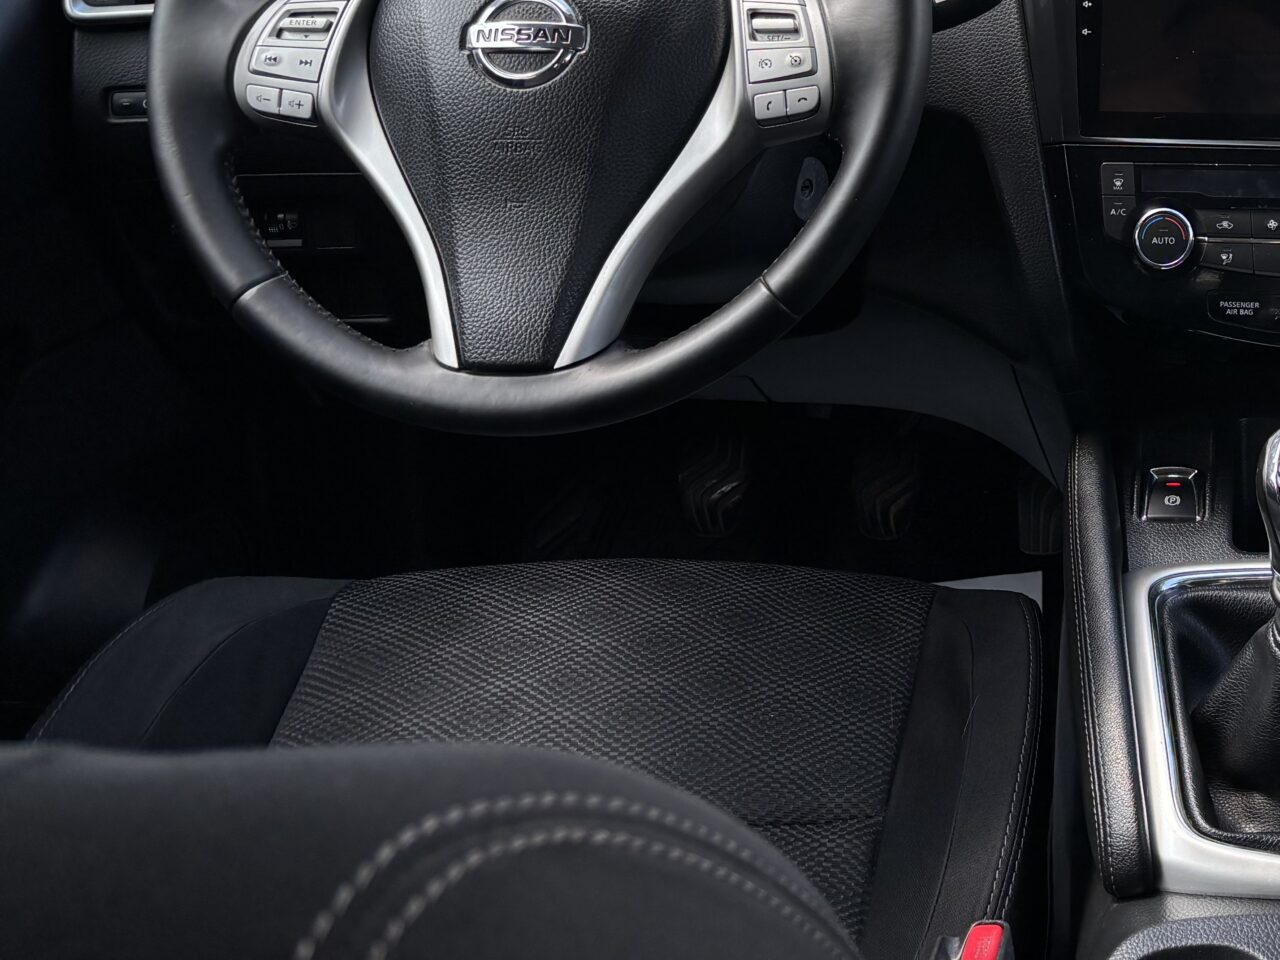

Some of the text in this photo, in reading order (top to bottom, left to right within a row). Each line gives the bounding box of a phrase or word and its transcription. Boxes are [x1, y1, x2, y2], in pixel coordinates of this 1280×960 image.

[289, 18, 317, 26] ENTER
[476, 26, 572, 45] NISSAN
[1110, 208, 1126, 216] A/C
[1151, 237, 1175, 245] AUTO
[1219, 301, 1260, 309] PASSENGER
[1239, 308, 1254, 316] BAG
